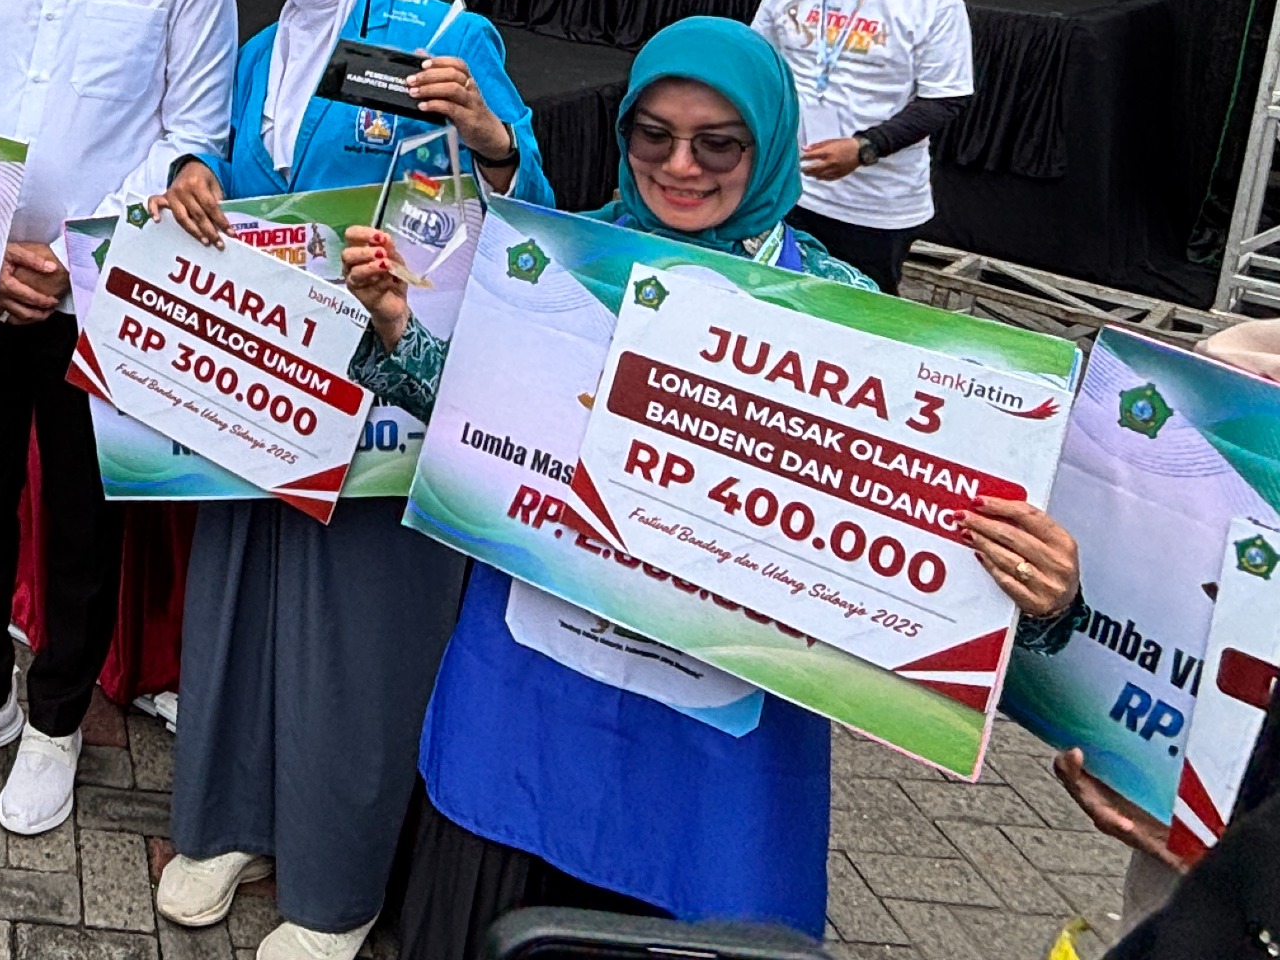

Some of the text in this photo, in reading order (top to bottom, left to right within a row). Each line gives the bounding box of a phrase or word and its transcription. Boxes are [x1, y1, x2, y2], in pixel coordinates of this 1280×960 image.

[131, 283, 331, 395] LOMBA VLOG UMUM
[168, 255, 318, 348] JUARA 1
[118, 314, 318, 436] RP 300.000
[699, 325, 946, 435] JUARA 3
[917, 362, 1023, 410] bankjatim
[266, 444, 299, 465] 2025
[461, 422, 575, 486] Lomba Mas
[645, 400, 958, 531] BANDENG DAN UDANG
[647, 367, 980, 498] LOMBA MASAK OLAHAN
[624, 439, 695, 489] RP
[707, 476, 947, 594] 400.000
[628, 507, 923, 638] Festival Bandeng dan Udang Sidoarjo 2025
[1109, 682, 1185, 757] RP.
